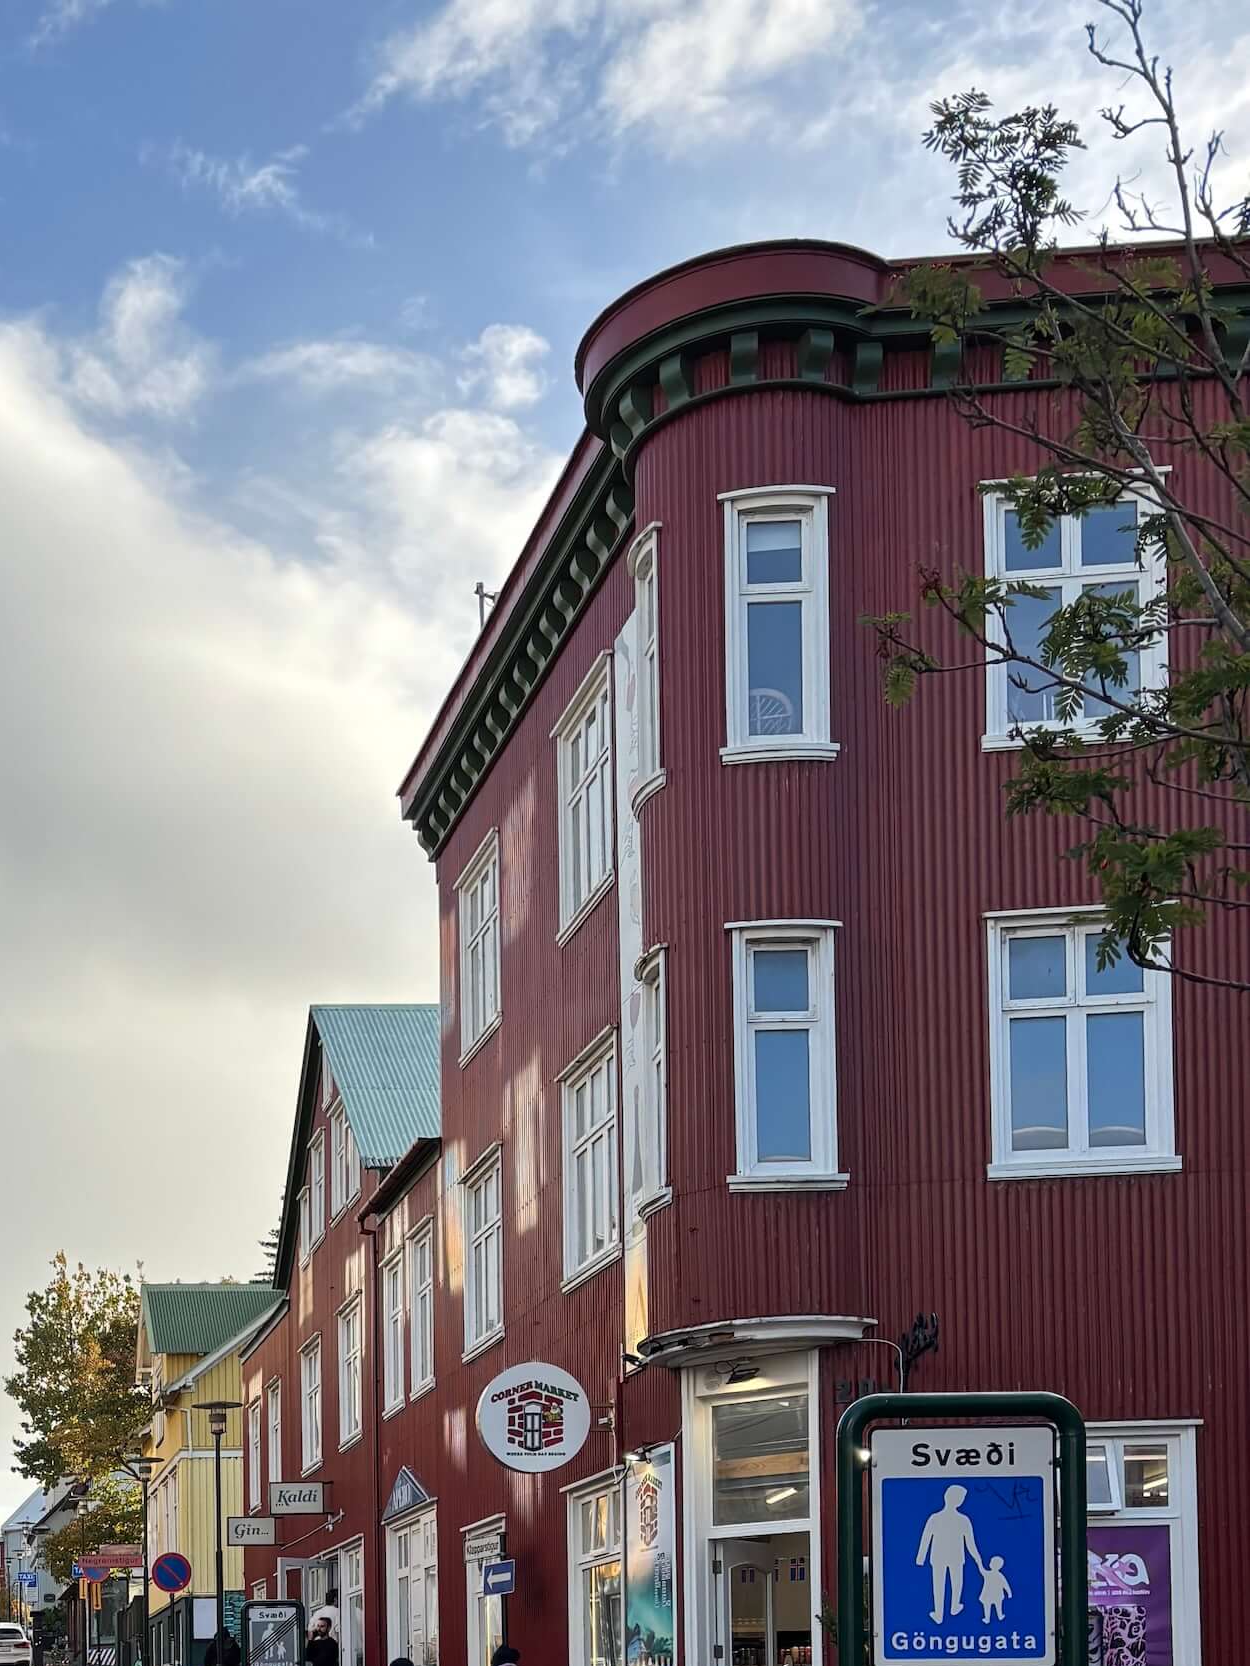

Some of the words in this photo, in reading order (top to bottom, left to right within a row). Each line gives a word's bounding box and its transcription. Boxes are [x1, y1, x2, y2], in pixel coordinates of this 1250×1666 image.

[491, 1381, 533, 1403] CORNER
[534, 1380, 580, 1402] MARKET
[911, 1442, 1015, 1467] Svæði
[891, 1631, 1036, 1653] Göngugata
